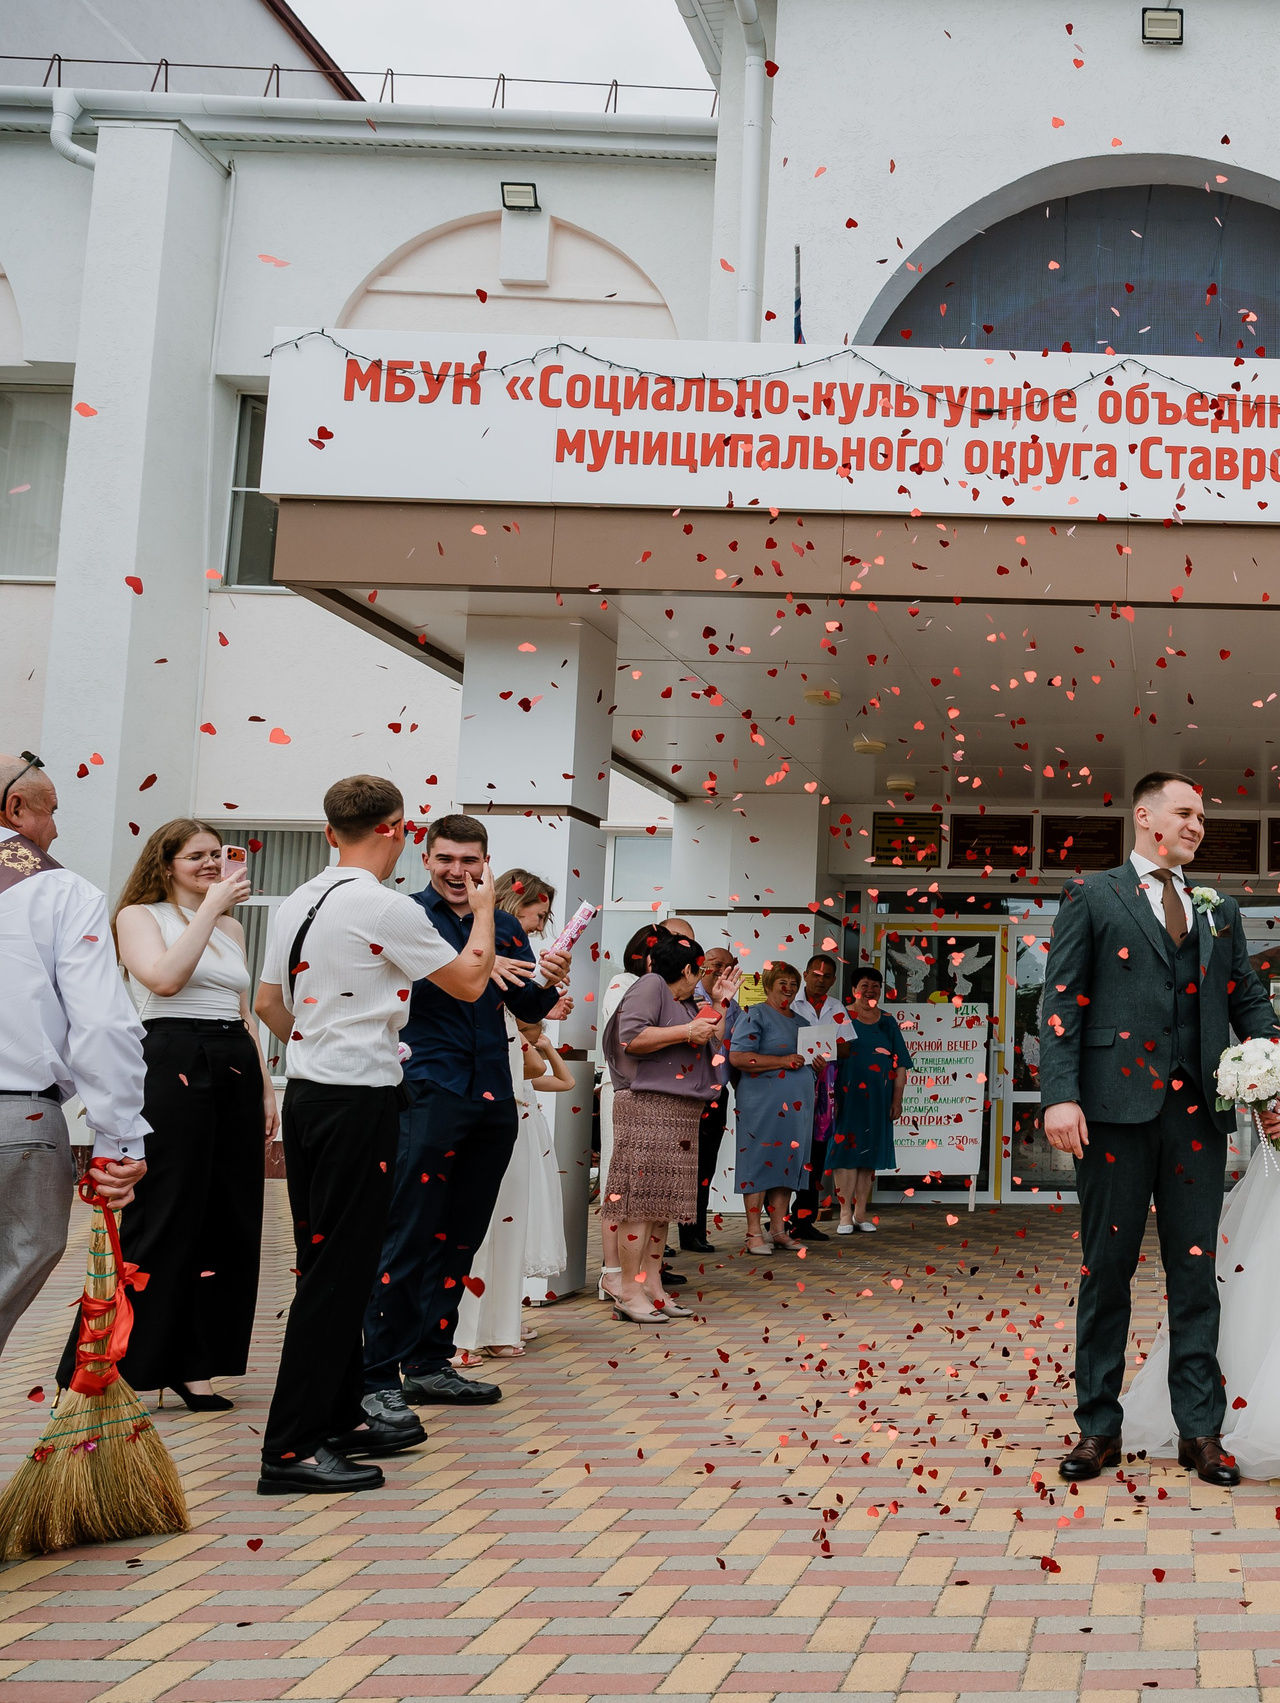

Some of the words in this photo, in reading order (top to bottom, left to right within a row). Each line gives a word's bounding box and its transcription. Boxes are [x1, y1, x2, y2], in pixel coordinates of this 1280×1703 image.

[343, 357, 482, 405] МБУК
[506, 364, 1078, 428] «Социально-культурное
[555, 428, 944, 474] муниципального
[964, 436, 1117, 485] округа
[955, 1004, 979, 1016] РДК
[905, 1038, 943, 1051] УСКНОЙ
[947, 1039, 978, 1051] ВЕЧЕР
[921, 1057, 975, 1065] ТАНЦЕВАЛЬНОГО
[901, 1096, 919, 1104] НОГО
[902, 1105, 939, 1113] НСАМБЛЯ
[947, 1135, 968, 1146] 250
